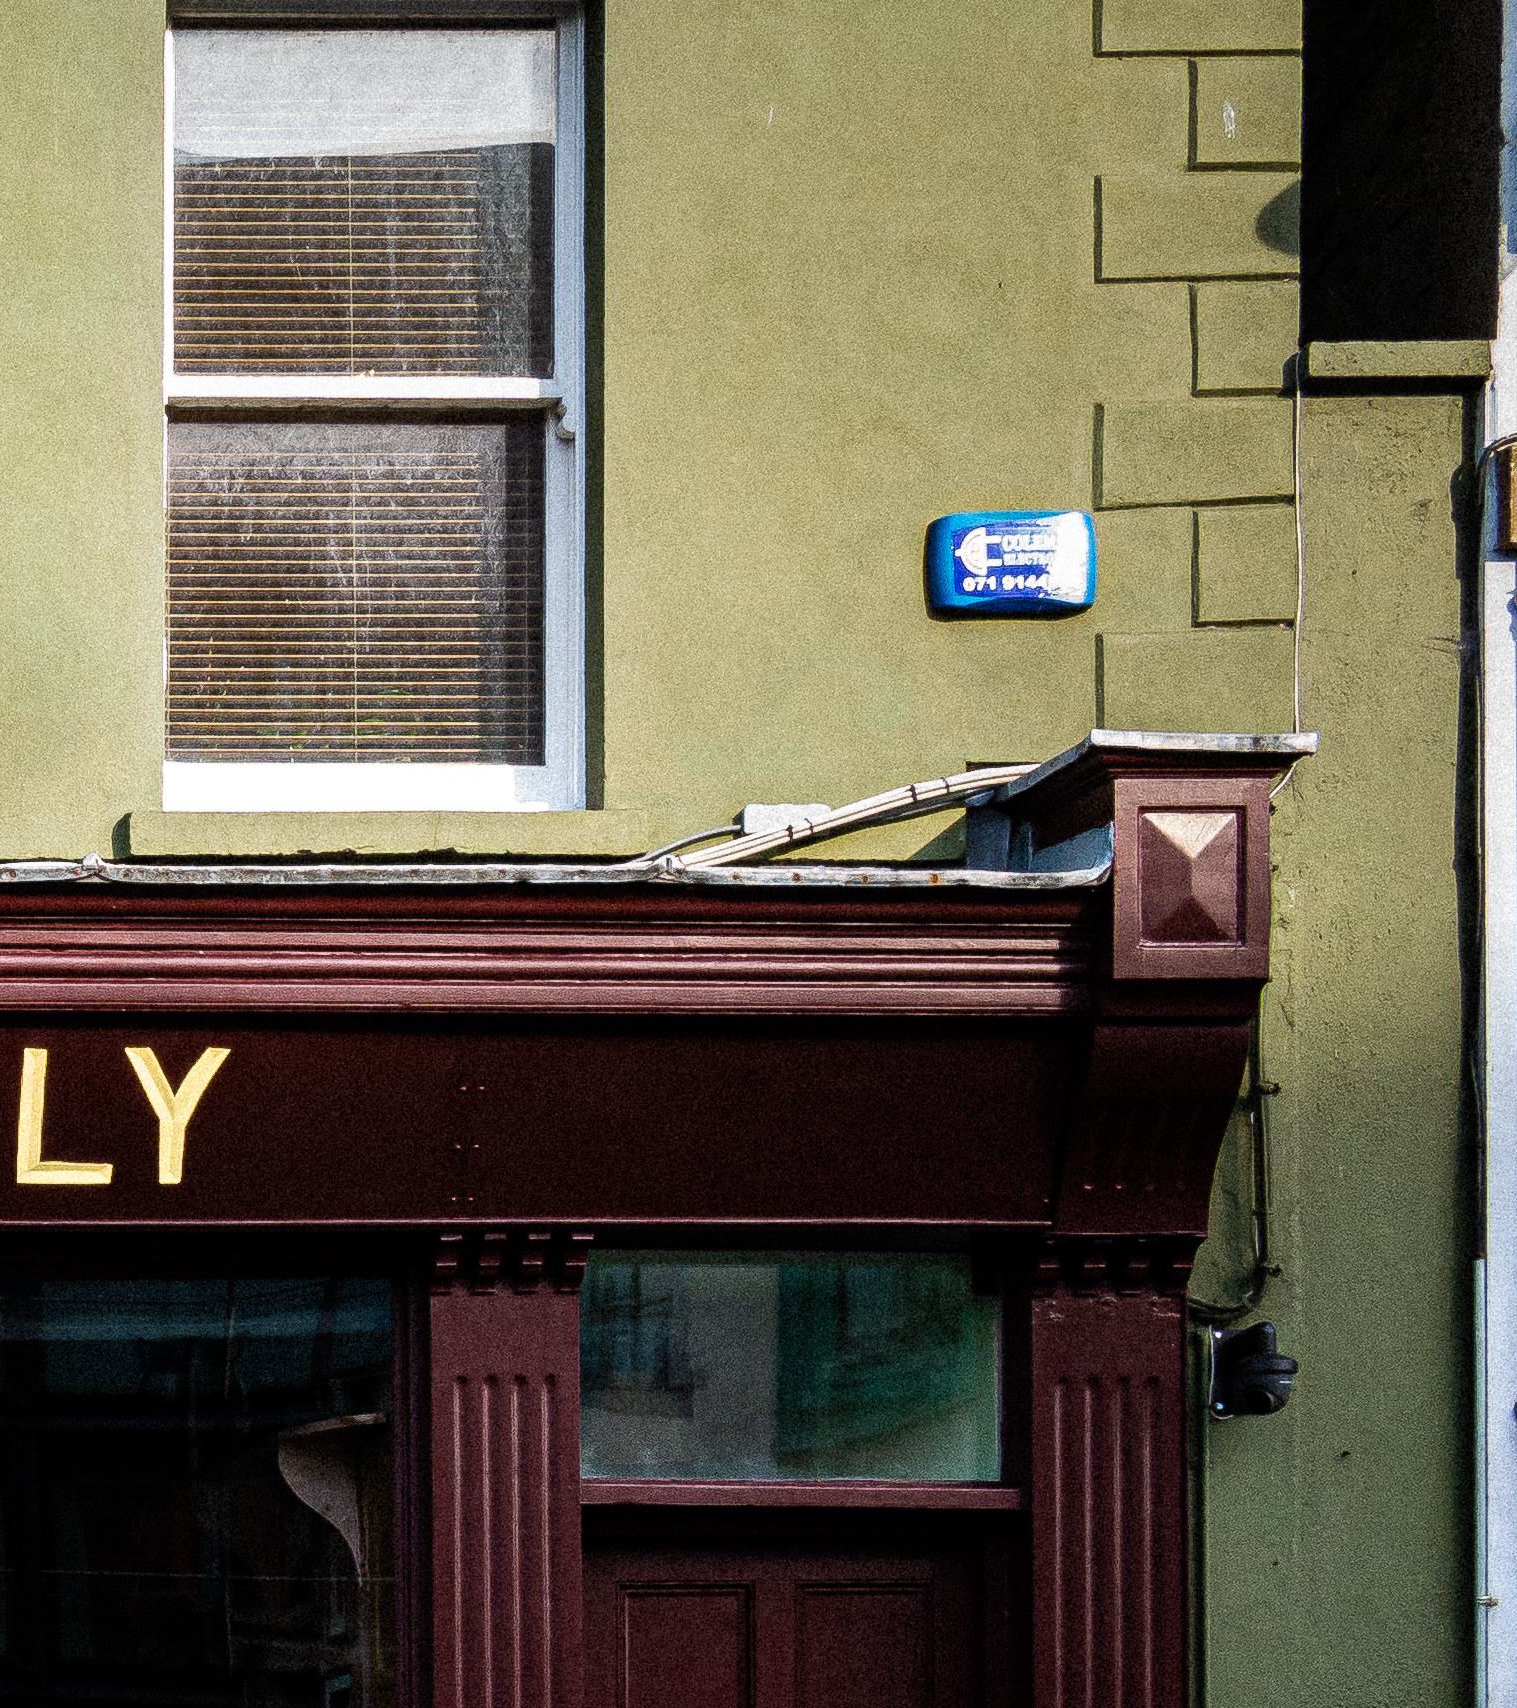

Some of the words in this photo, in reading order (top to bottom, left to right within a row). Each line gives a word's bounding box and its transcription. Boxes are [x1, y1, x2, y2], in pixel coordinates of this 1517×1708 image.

[1002, 534, 1057, 552] COLEM
[962, 576, 997, 592] 071
[1001, 574, 1050, 591] 9144
